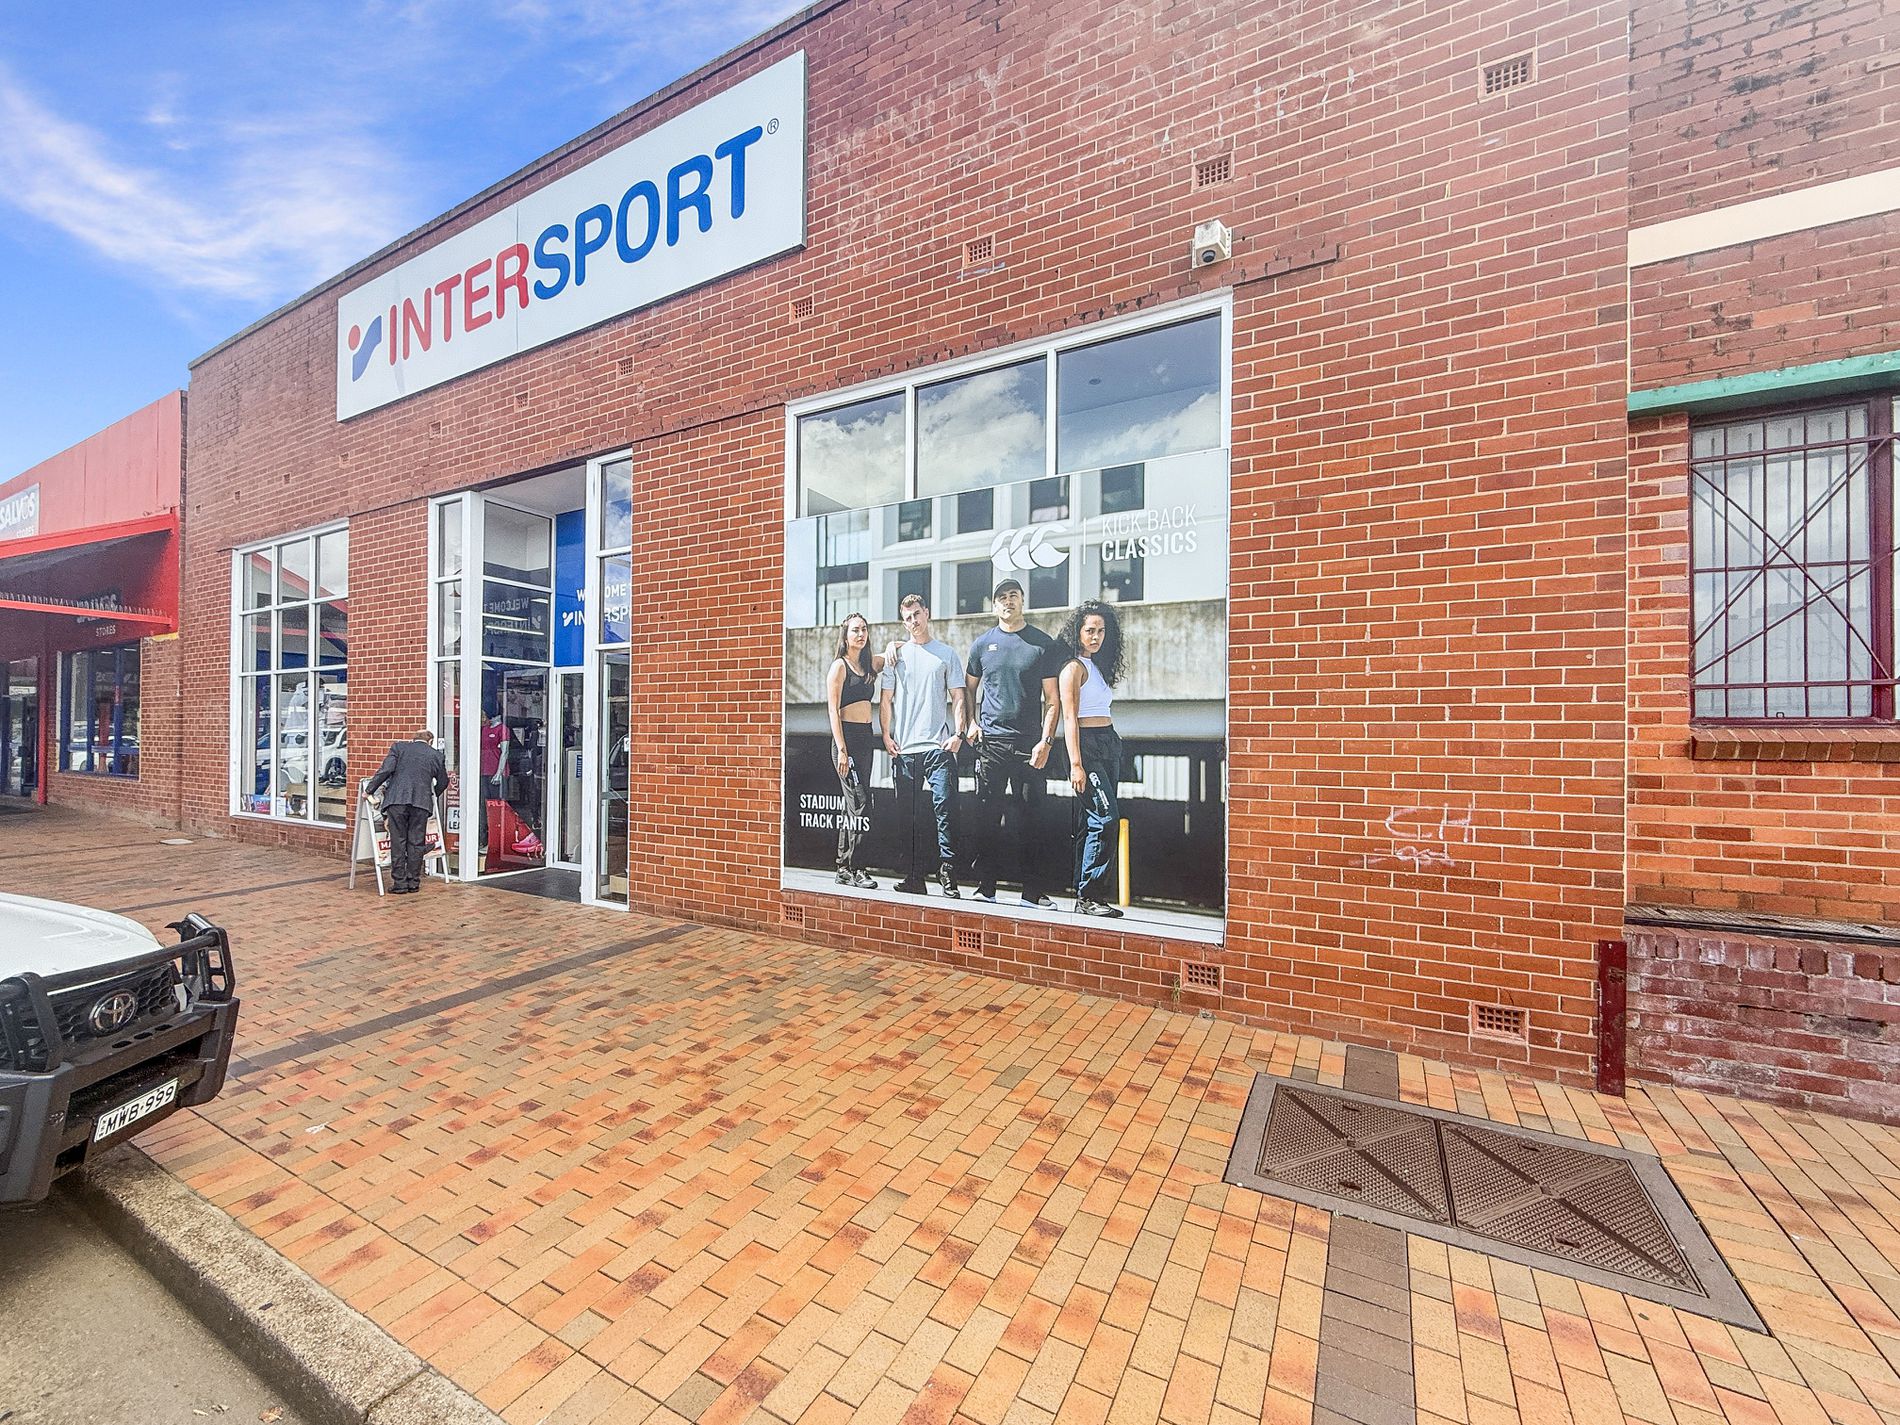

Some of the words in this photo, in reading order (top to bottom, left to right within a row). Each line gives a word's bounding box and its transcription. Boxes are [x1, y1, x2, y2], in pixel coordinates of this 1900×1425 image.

[389, 125, 763, 366] INTERSPORT
[1102, 512, 1142, 537] KICK
[1147, 503, 1197, 532] BACK
[1101, 530, 1197, 562] CLASSICS
[800, 793, 846, 811] STADIUM
[800, 812, 833, 829] TRACK
[836, 814, 870, 832] PANTS
